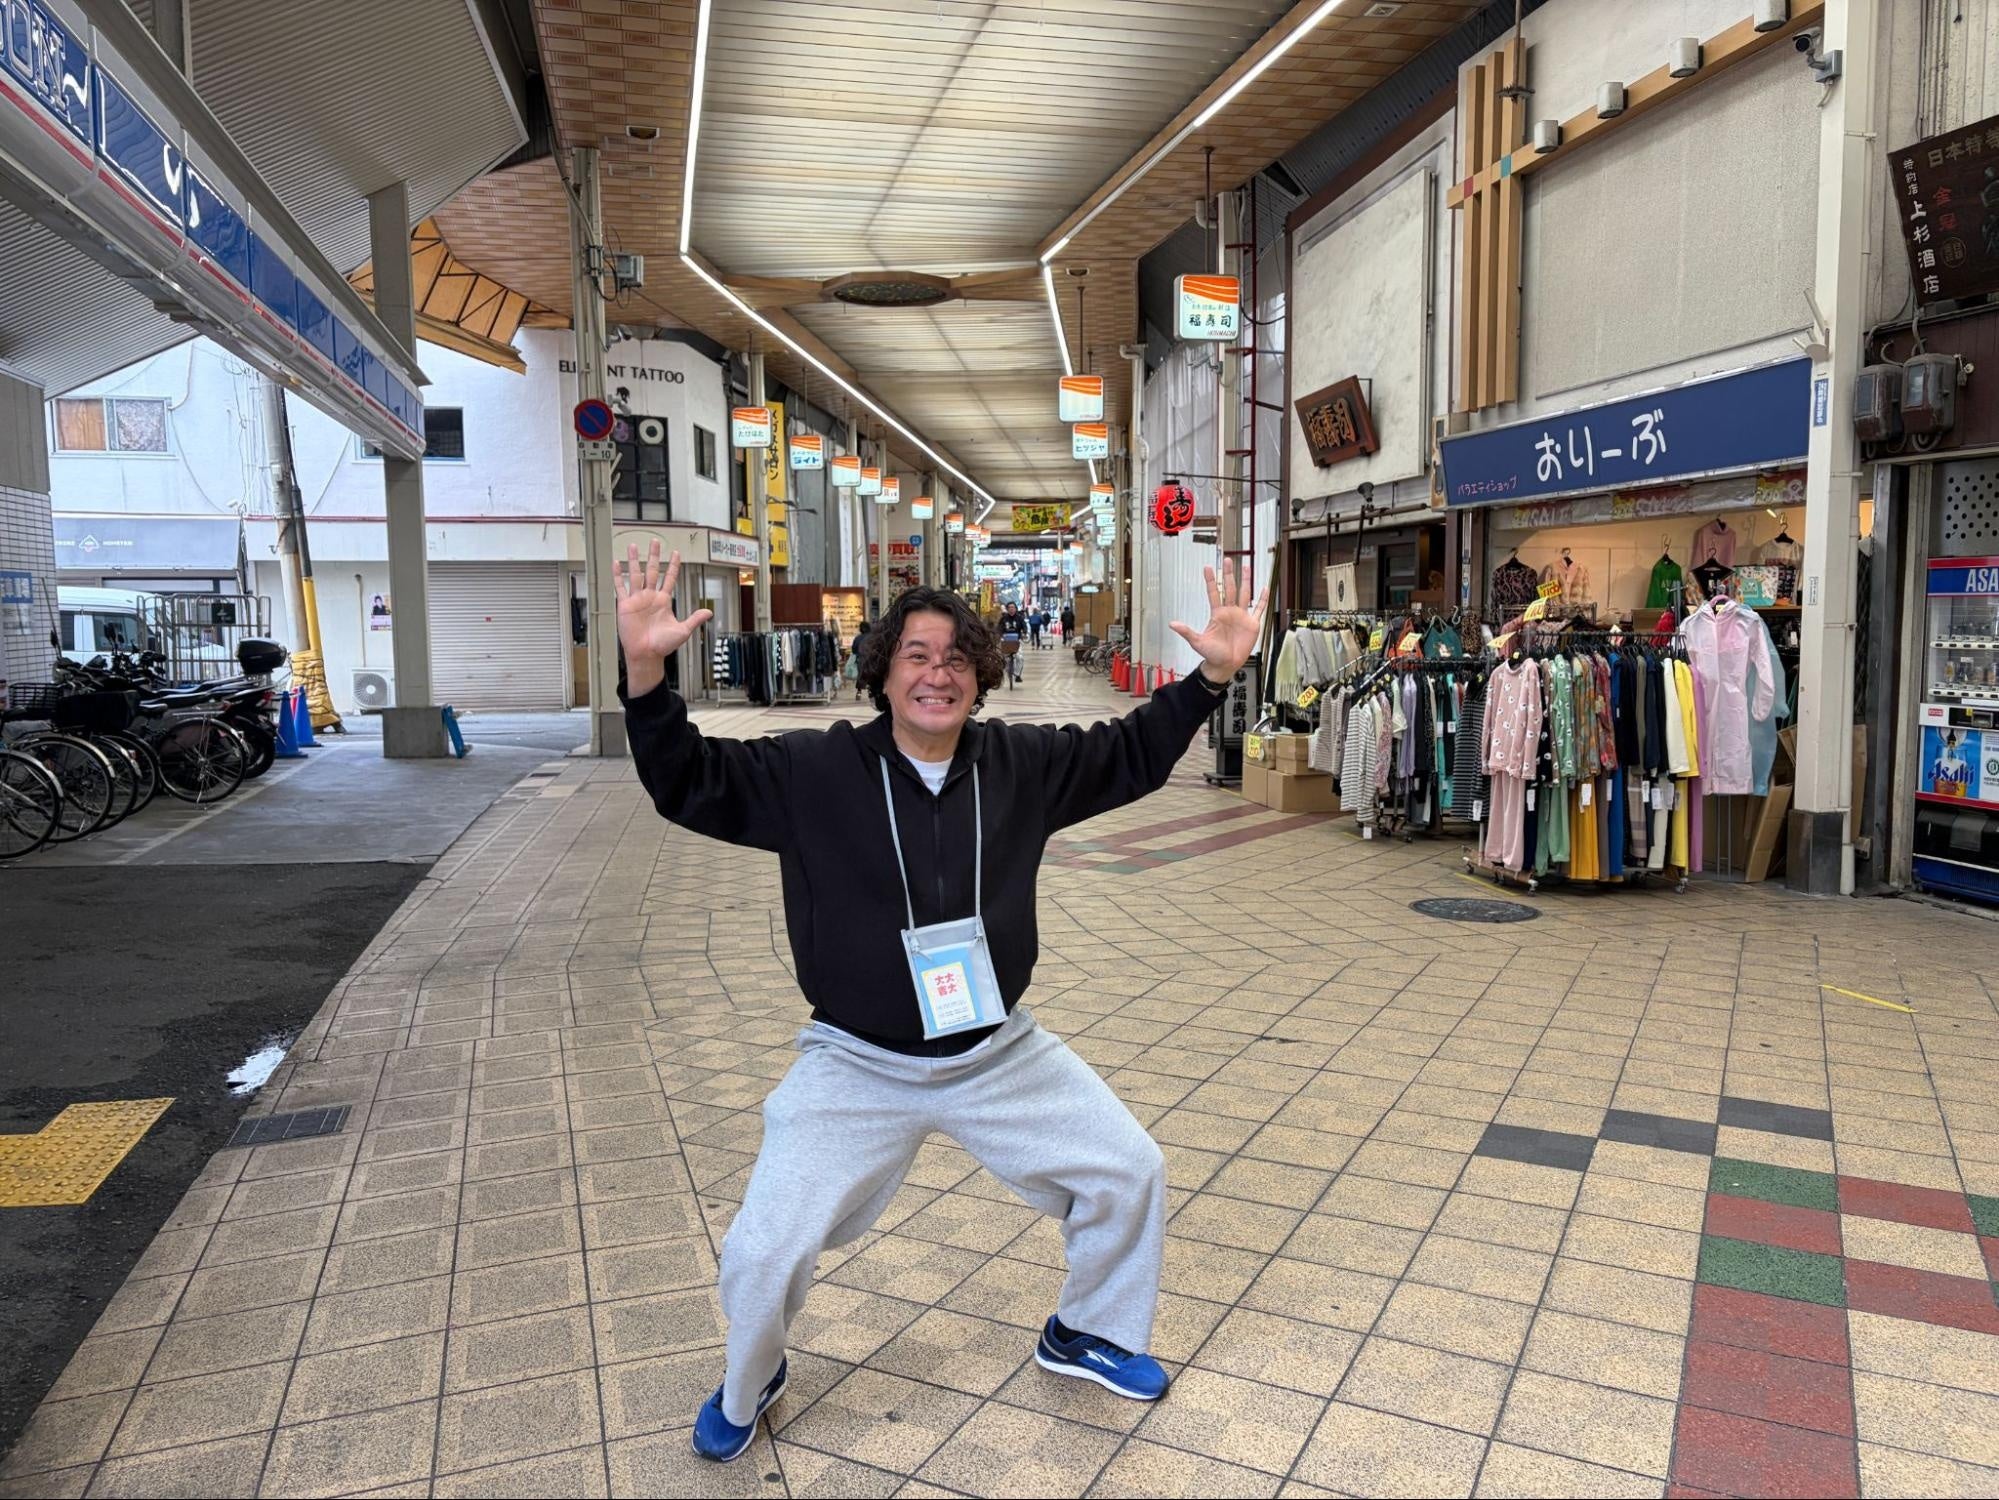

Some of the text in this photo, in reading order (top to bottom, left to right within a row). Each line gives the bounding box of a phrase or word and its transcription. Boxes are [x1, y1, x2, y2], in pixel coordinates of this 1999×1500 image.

[0, 0, 66, 112] ON
[1910, 201, 1940, 294] 上杉酒店
[630, 366, 685, 385] TATTOO
[1534, 408, 1667, 482] おりーぶ
[1457, 475, 1519, 497] バラエティショップ
[1927, 761, 1975, 786] Asahi
